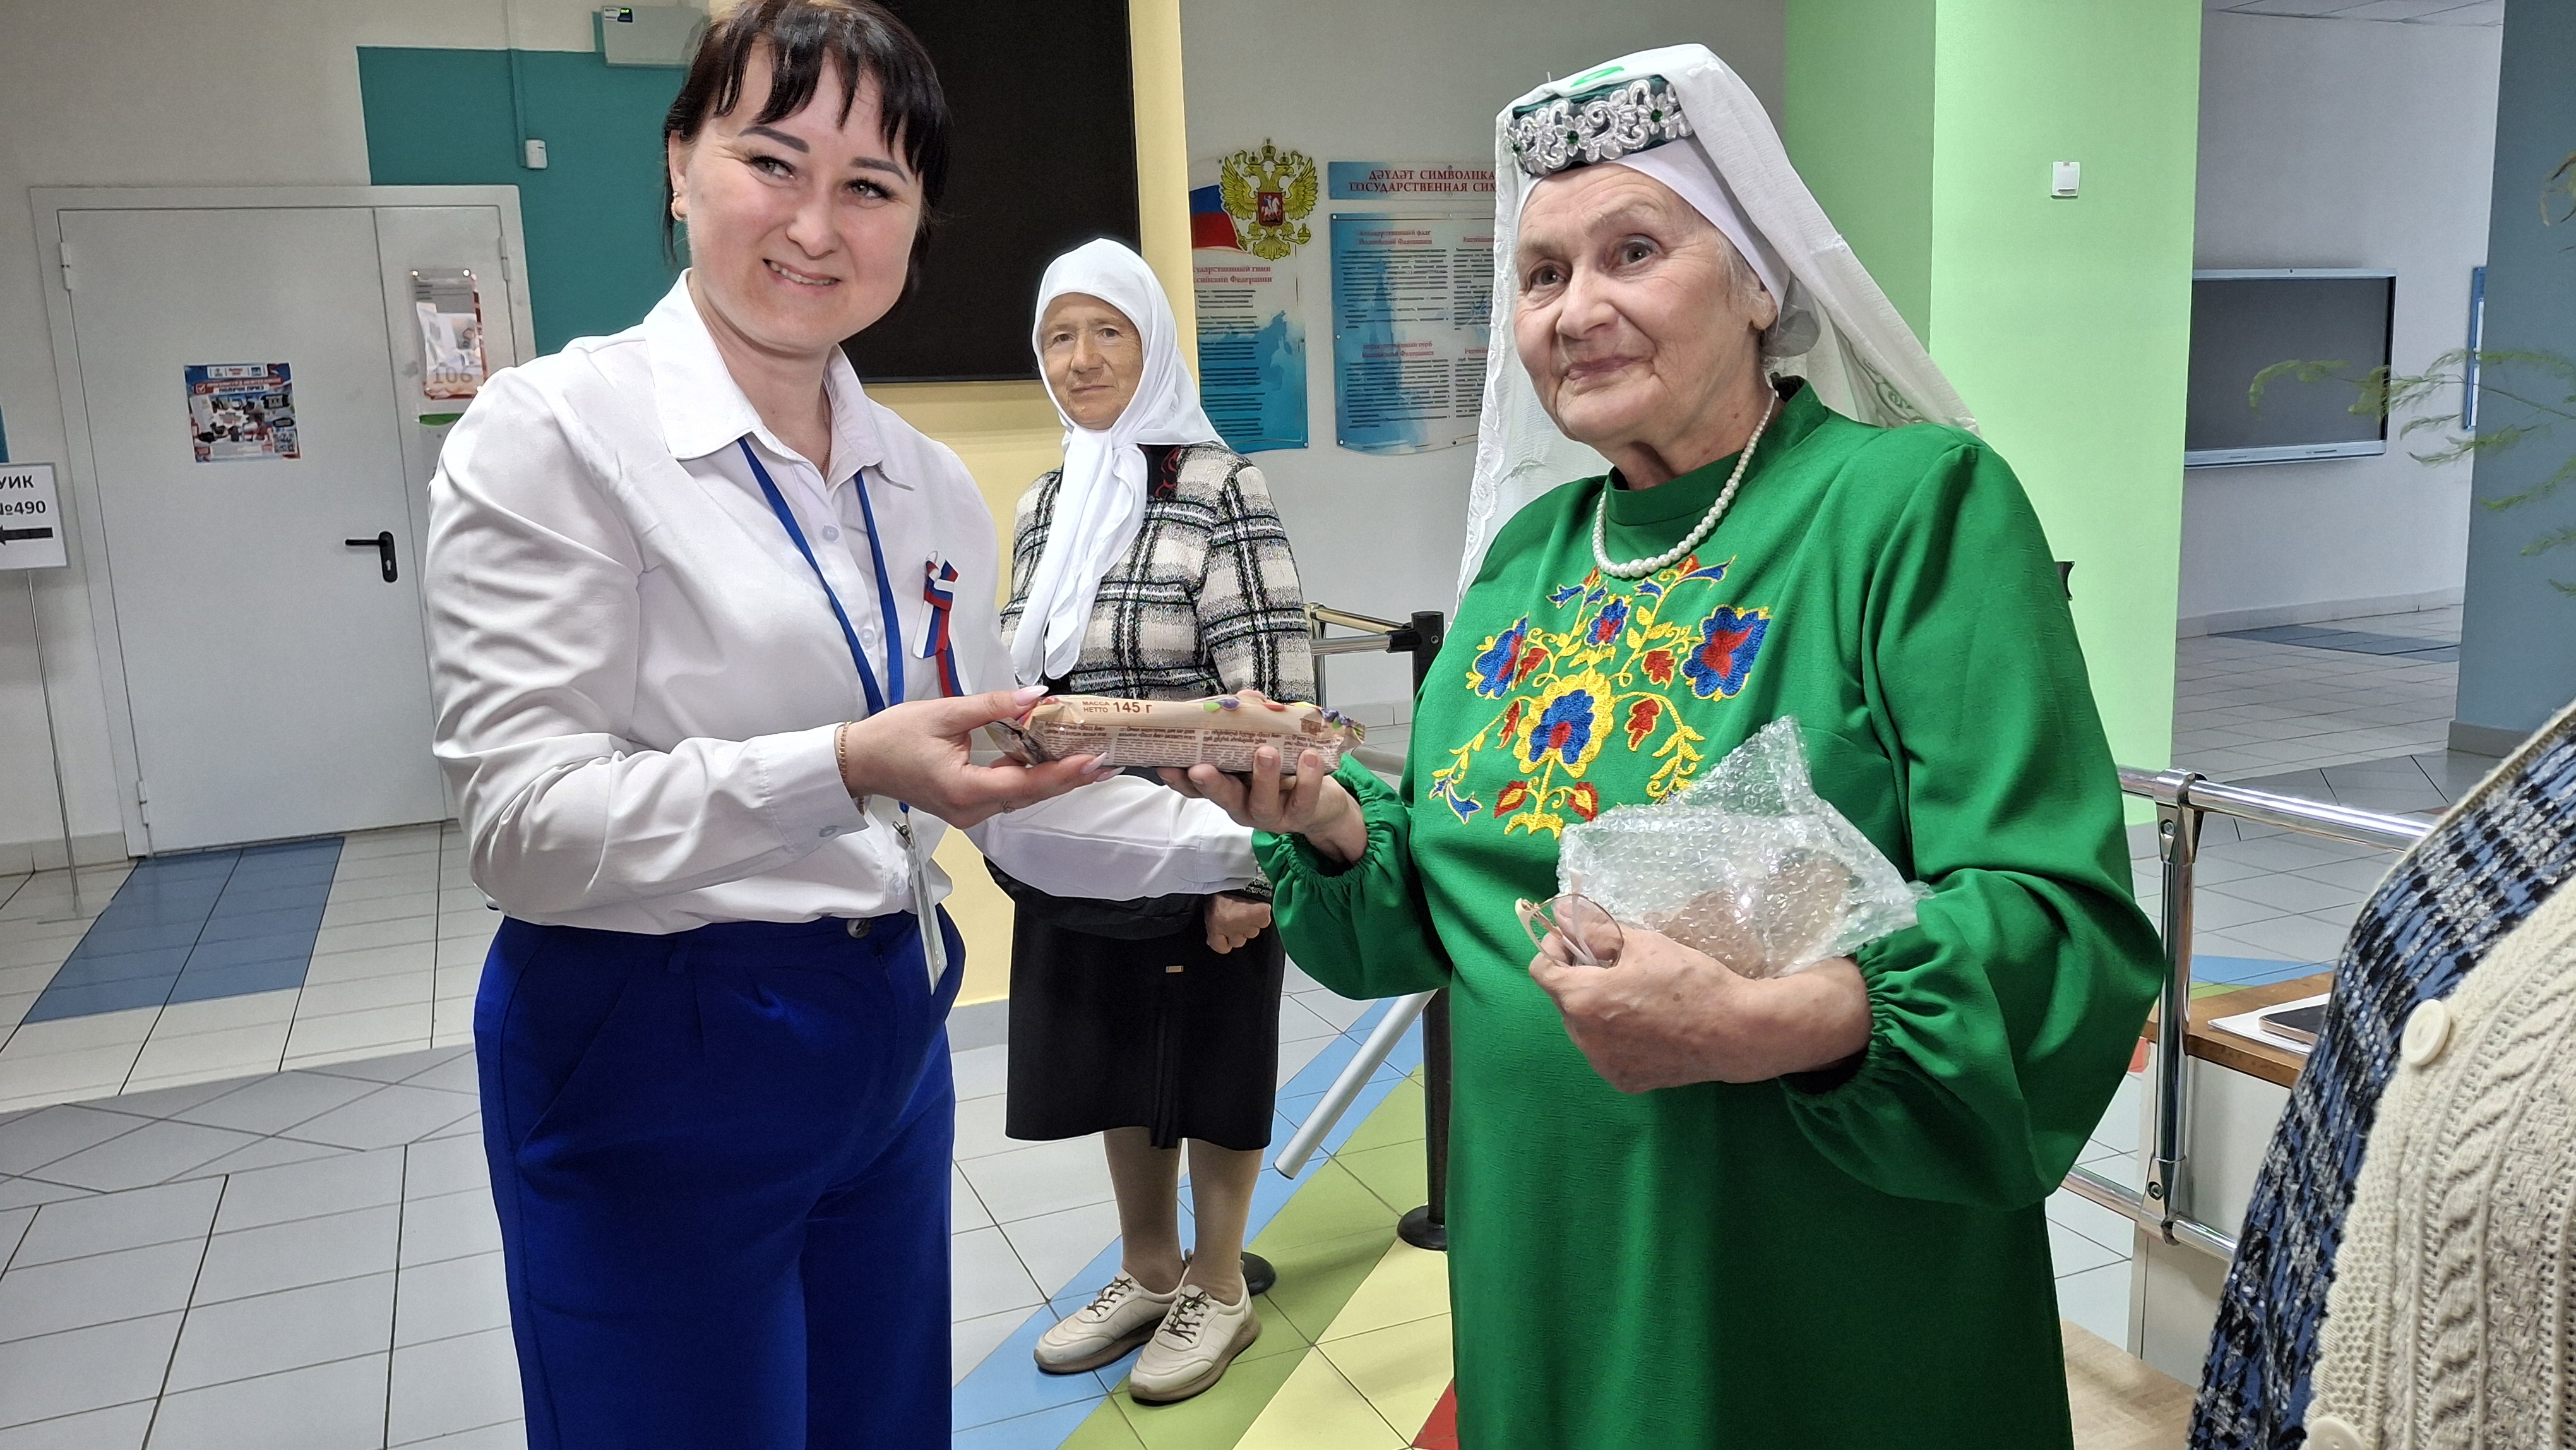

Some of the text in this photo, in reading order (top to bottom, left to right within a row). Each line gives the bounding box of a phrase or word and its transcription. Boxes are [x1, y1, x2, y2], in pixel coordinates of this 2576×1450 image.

[1420, 170, 1496, 180] СИМВОЛИКА
[1349, 182, 1467, 193] ГОСУДАРСТВЕННАЯ
[0, 475, 34, 489] УИК
[0, 500, 46, 515] №490
[1113, 702, 1140, 713] 145
